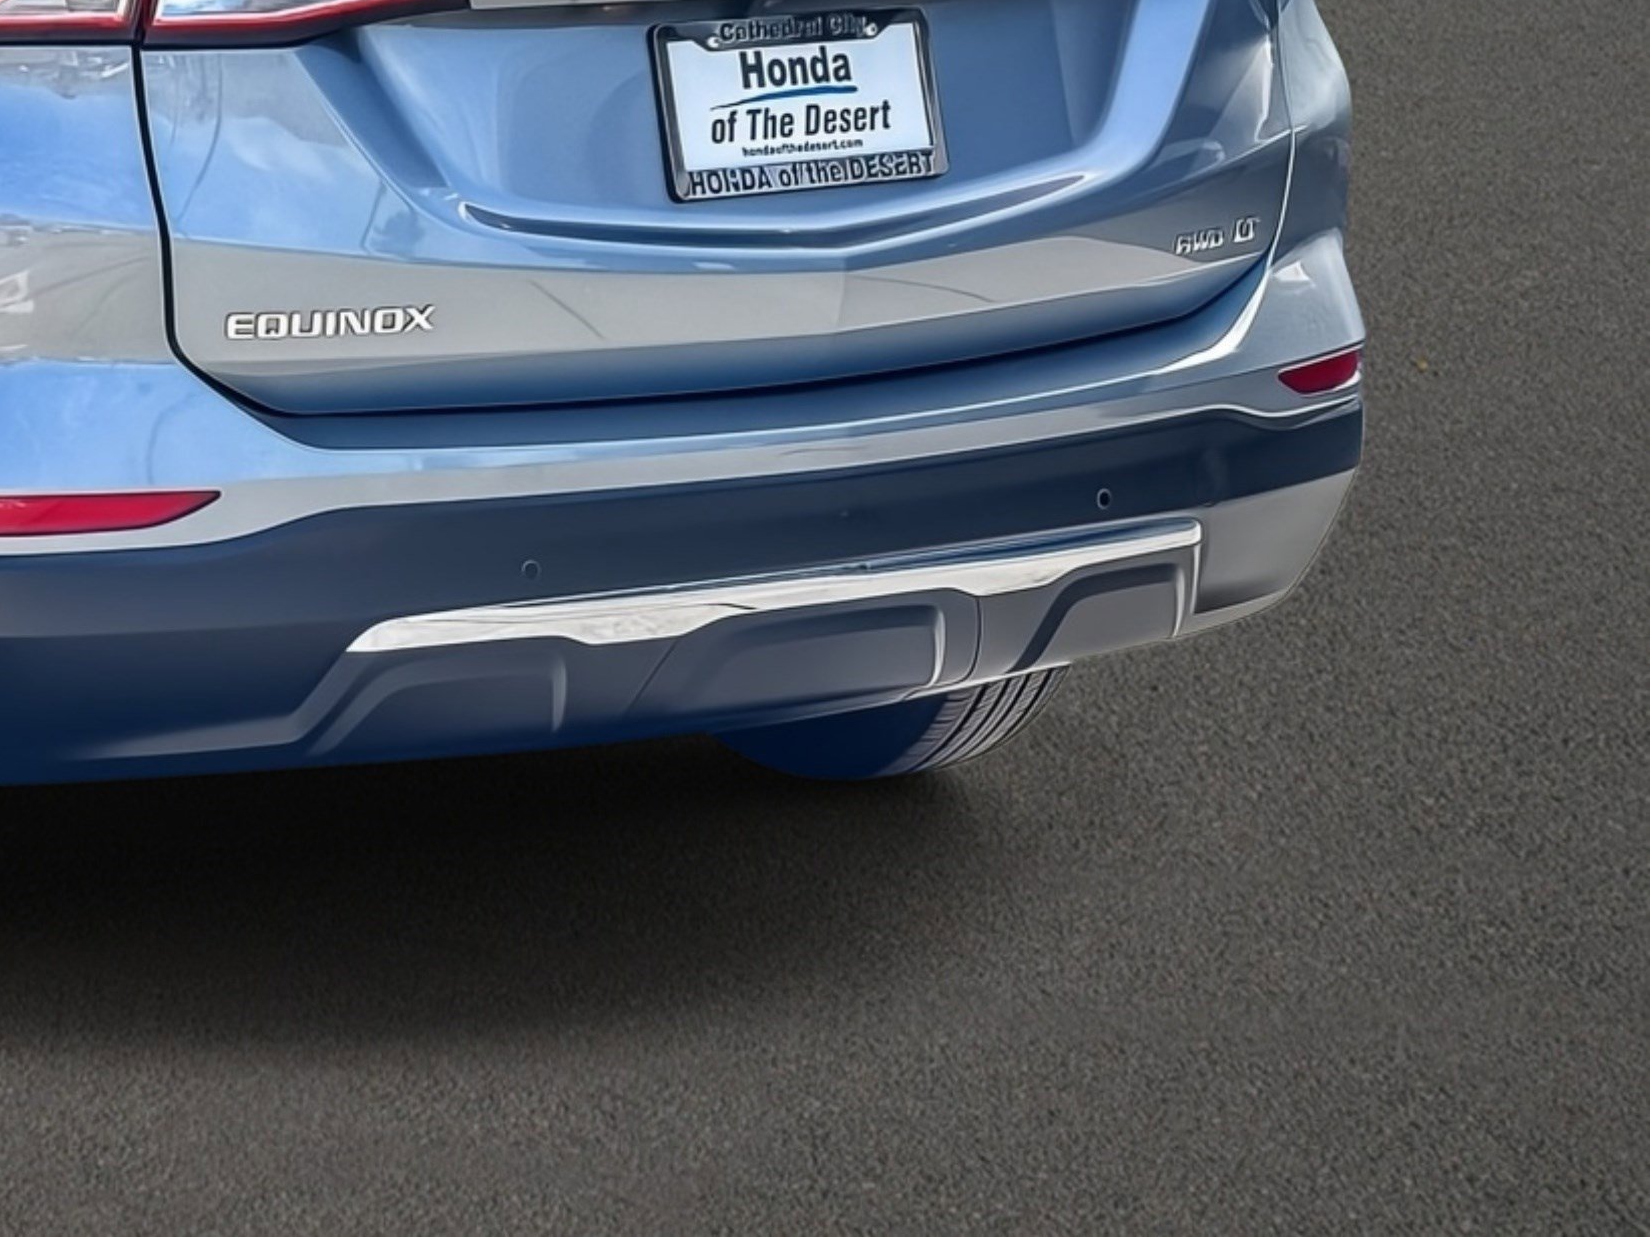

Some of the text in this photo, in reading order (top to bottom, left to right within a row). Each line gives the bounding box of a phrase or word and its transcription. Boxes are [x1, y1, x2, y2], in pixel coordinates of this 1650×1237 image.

[739, 46, 852, 89] Honda
[711, 99, 891, 144] of The Desert
[742, 138, 864, 157] hondaofthedesert.com
[689, 151, 935, 196] HONDA of the DESERT
[1175, 217, 1261, 255] AWD LT
[226, 305, 437, 339] EQUINOX
